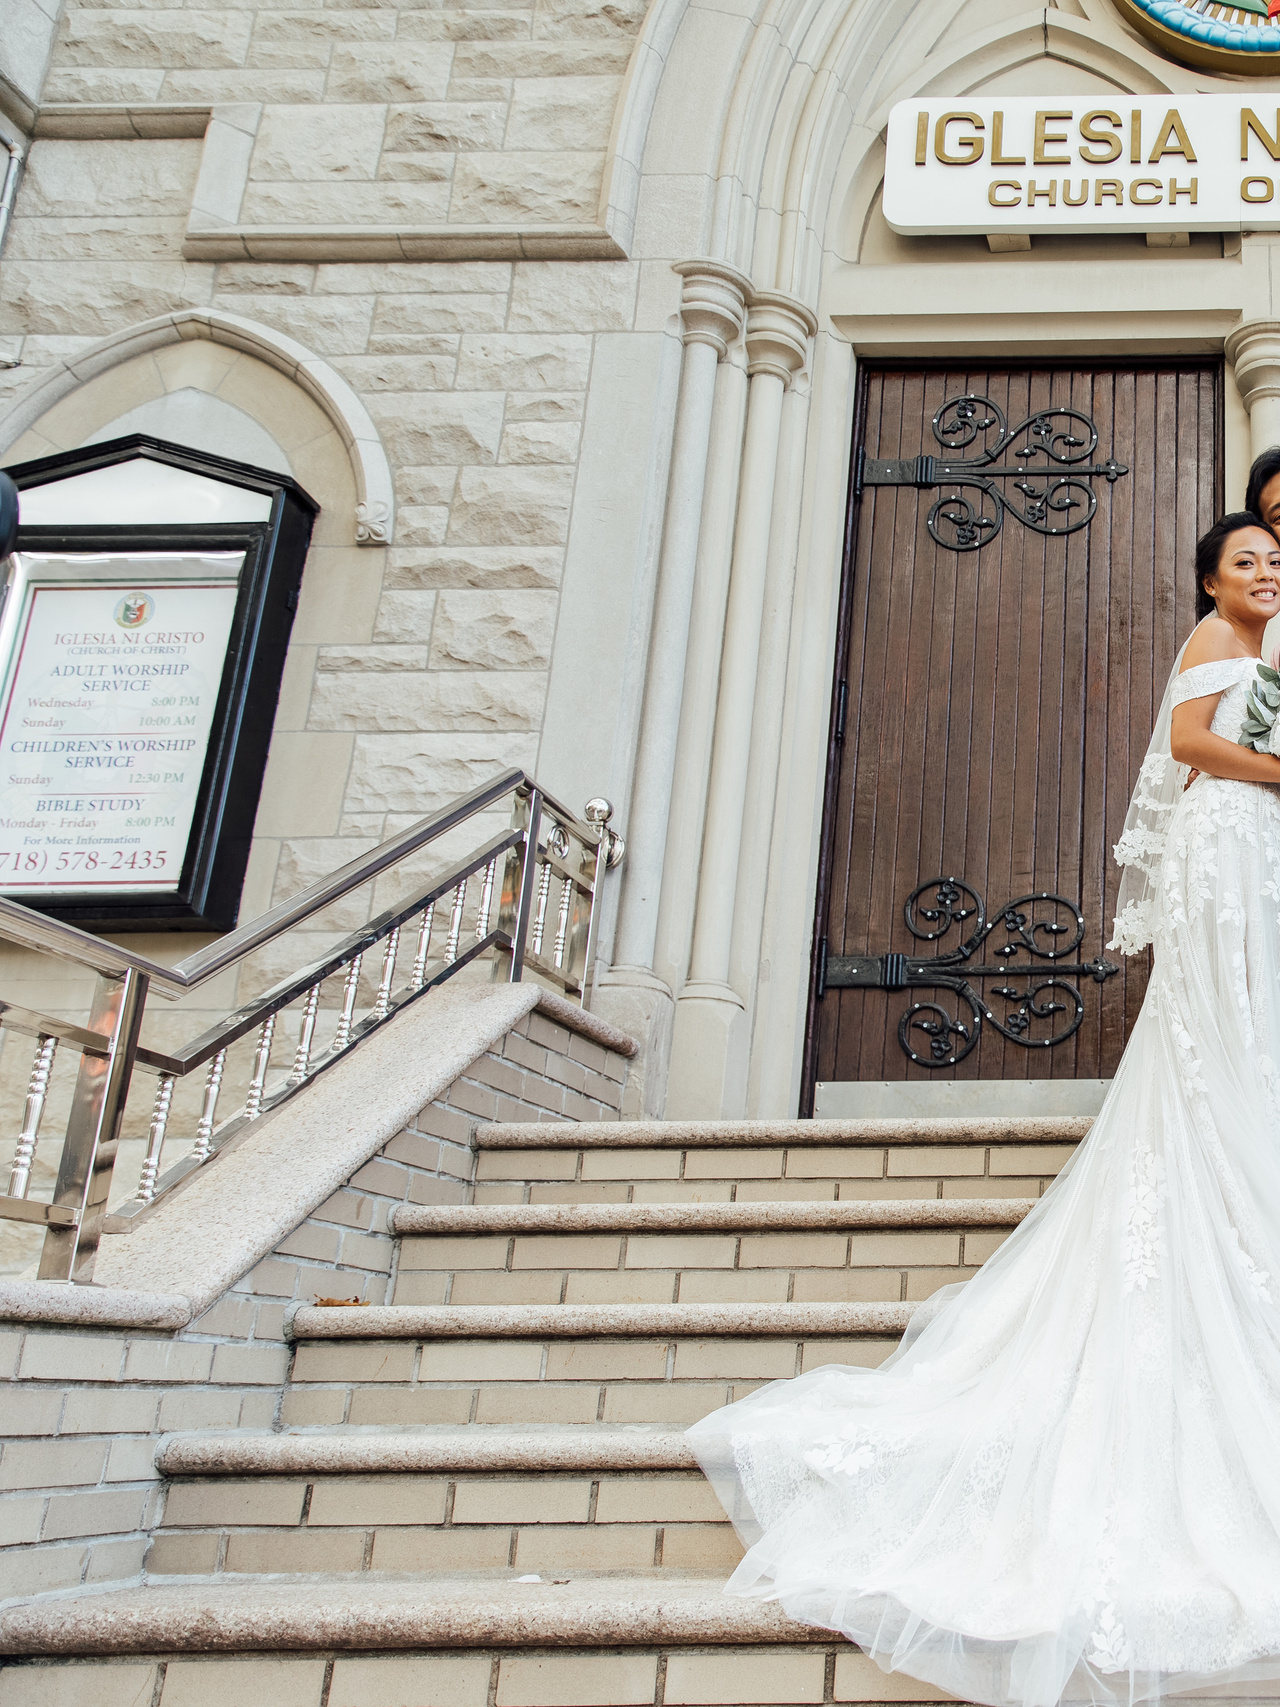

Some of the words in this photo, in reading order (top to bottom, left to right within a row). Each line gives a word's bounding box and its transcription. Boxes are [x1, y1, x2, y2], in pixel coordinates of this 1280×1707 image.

[913, 108, 1198, 167] IGLESIA
[987, 177, 1199, 208] CHURCH
[54, 633, 116, 646] IGLESIA
[121, 632, 142, 645] NI
[145, 631, 205, 645] CRISTO
[67, 646, 122, 657] (CHURCH
[123, 646, 140, 656] OF
[141, 645, 187, 656] CHRIST)
[50, 664, 109, 677] ADULT
[112, 663, 190, 676] WORSHIP
[82, 679, 152, 692] SERVICE
[27, 697, 95, 709] Wednesday
[179, 696, 200, 706] PM
[21, 717, 67, 729] Sunday
[138, 716, 171, 727] 10:00
[172, 715, 196, 726] AM
[10, 740, 113, 753] CHILDREN'S
[117, 739, 197, 752] WORSHIP
[64, 756, 136, 768] SERVICE
[8, 774, 54, 786] Sunday
[128, 773, 161, 784] 12:30
[162, 772, 185, 783] PM
[36, 799, 87, 812] BIBLE
[88, 798, 146, 811] STUDY
[0, 818, 49, 832] Monday
[58, 817, 99, 831] Friday
[125, 816, 153, 828] 8:00
[153, 816, 176, 827] PM
[23, 836, 43, 846] For
[45, 835, 74, 846] More
[76, 834, 141, 846] Information
[55, 850, 168, 871] 578-2435
